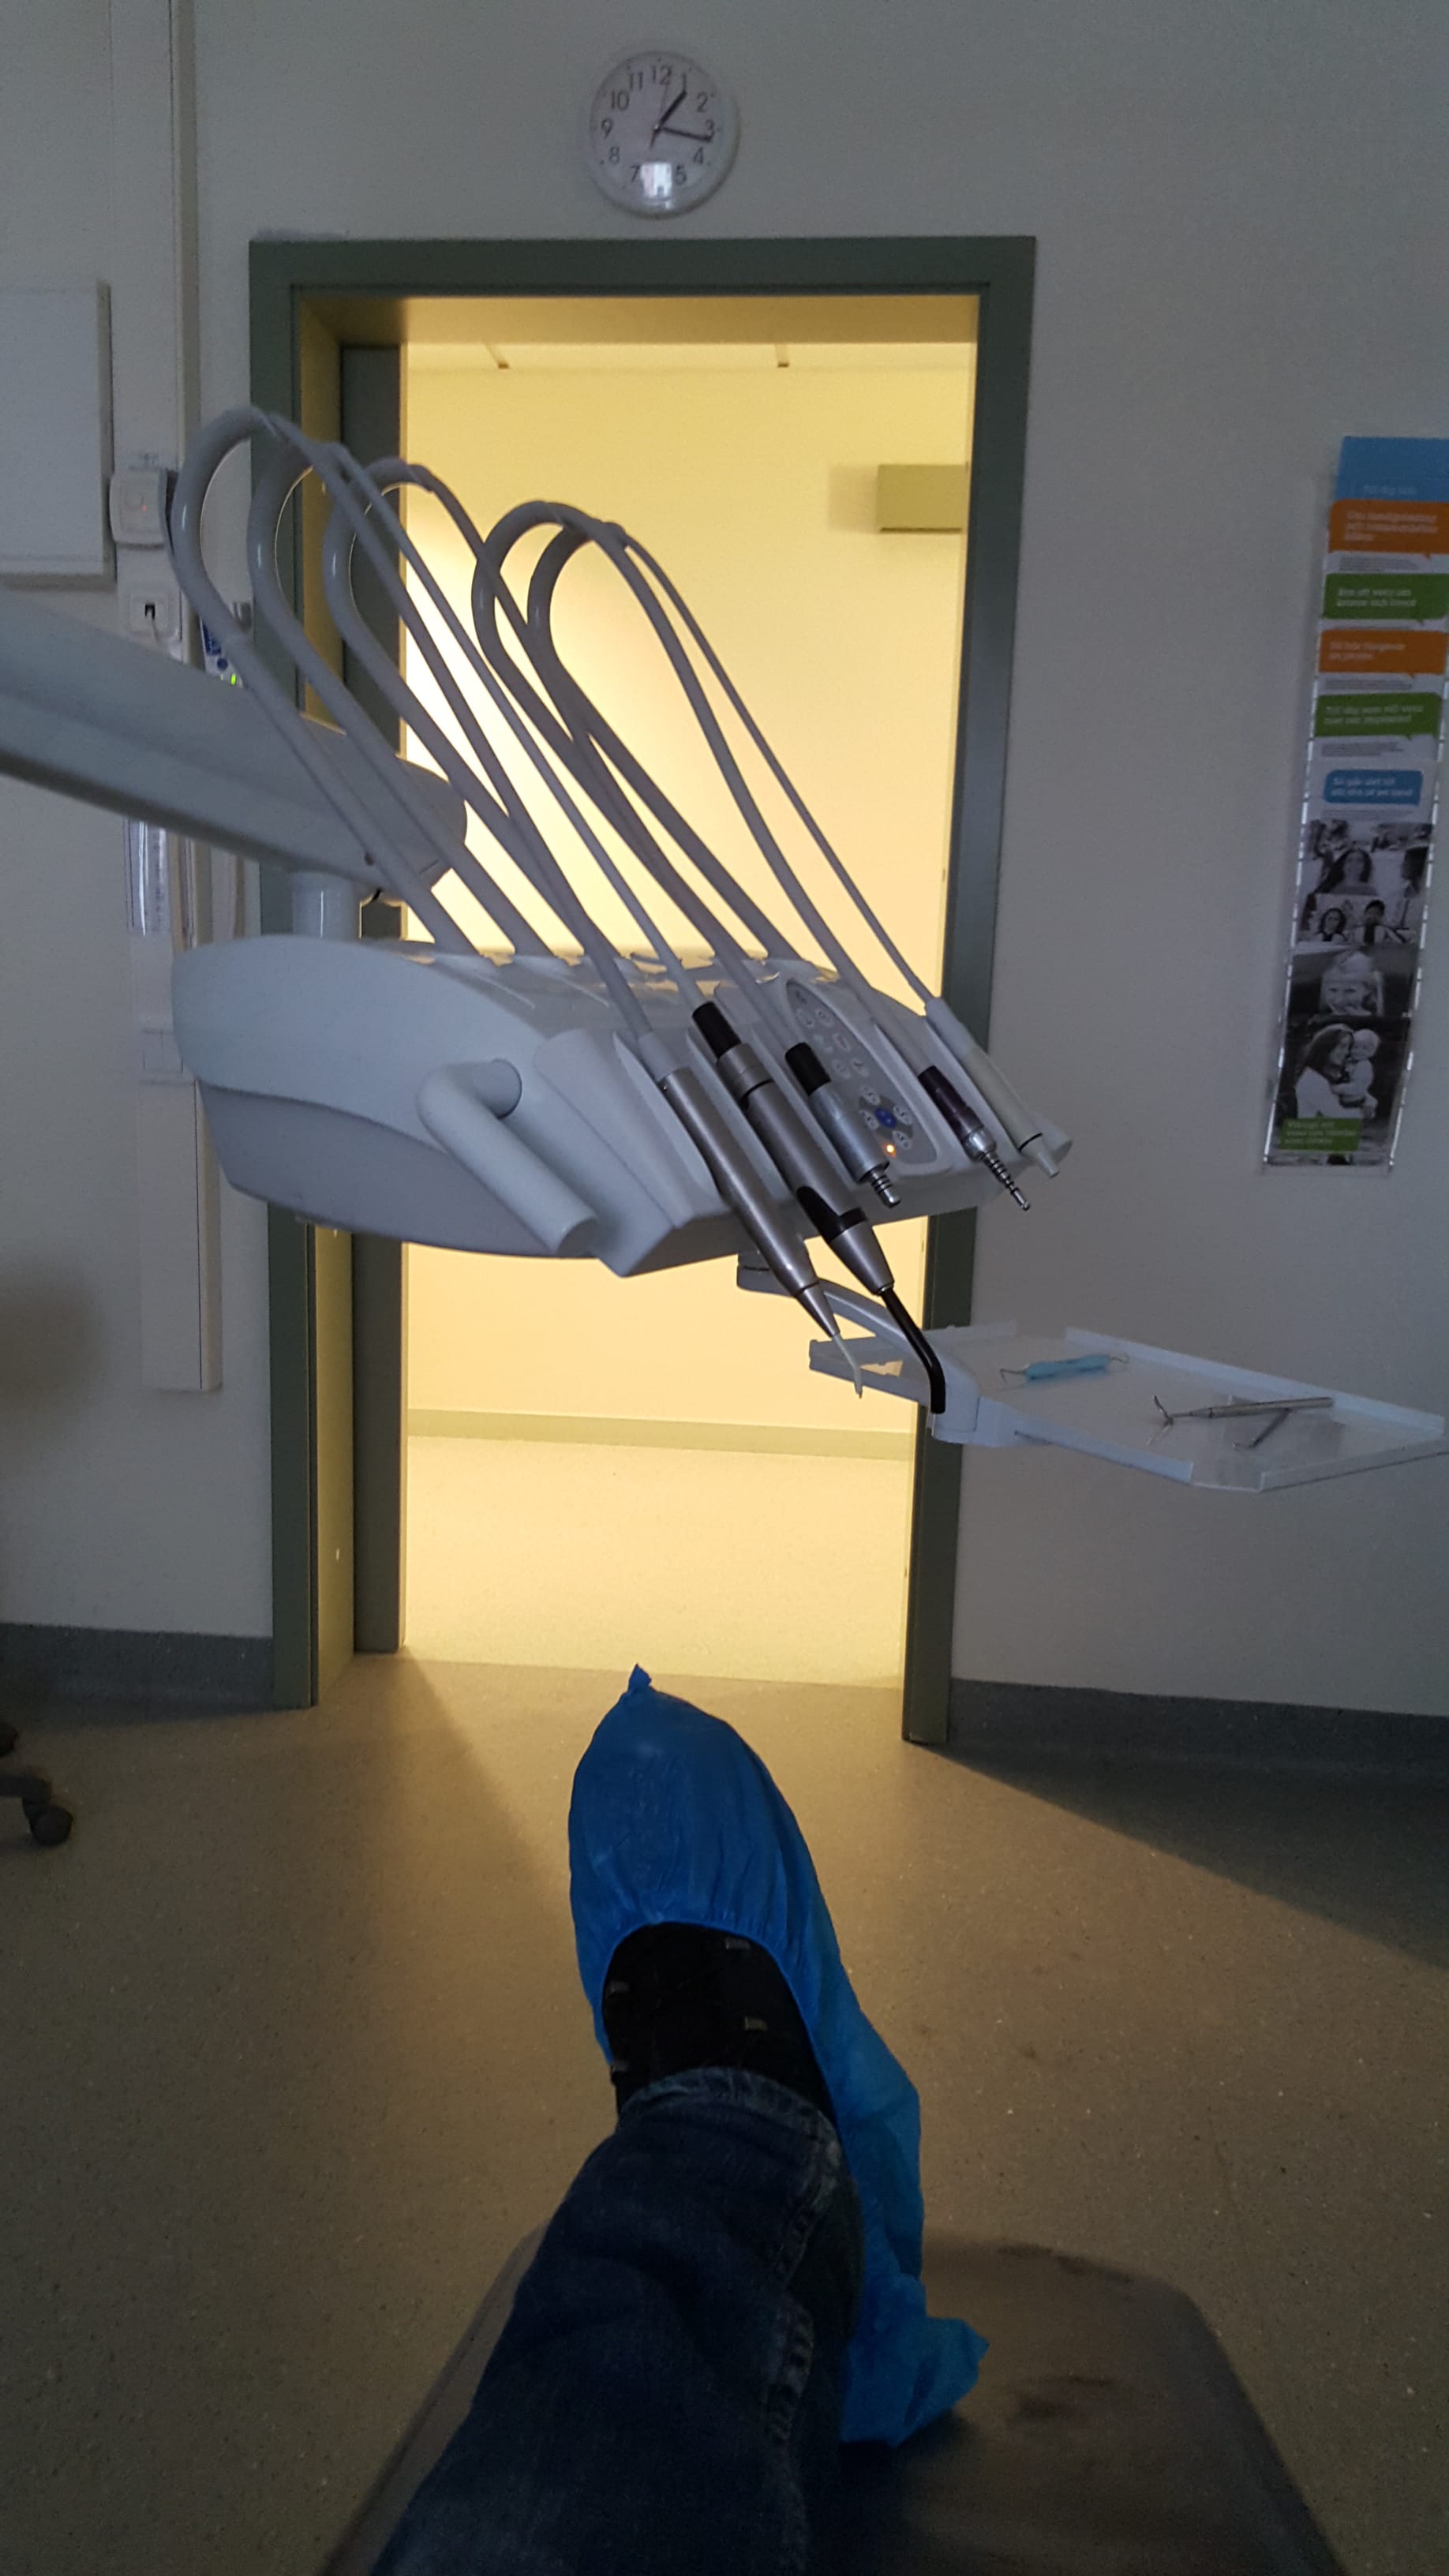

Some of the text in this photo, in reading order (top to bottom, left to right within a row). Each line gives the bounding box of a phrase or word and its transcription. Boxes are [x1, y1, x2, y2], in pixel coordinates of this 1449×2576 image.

[630, 71, 644, 92] 11
[650, 64, 672, 85] 12
[680, 73, 687, 92] 1
[611, 90, 630, 111] 10
[697, 92, 709, 113] 2
[601, 119, 612, 139] 9
[706, 119, 715, 140] 3
[609, 146, 621, 165] 8
[693, 146, 704, 165] 4
[631, 164, 641, 182] 7
[675, 165, 687, 185] 5
